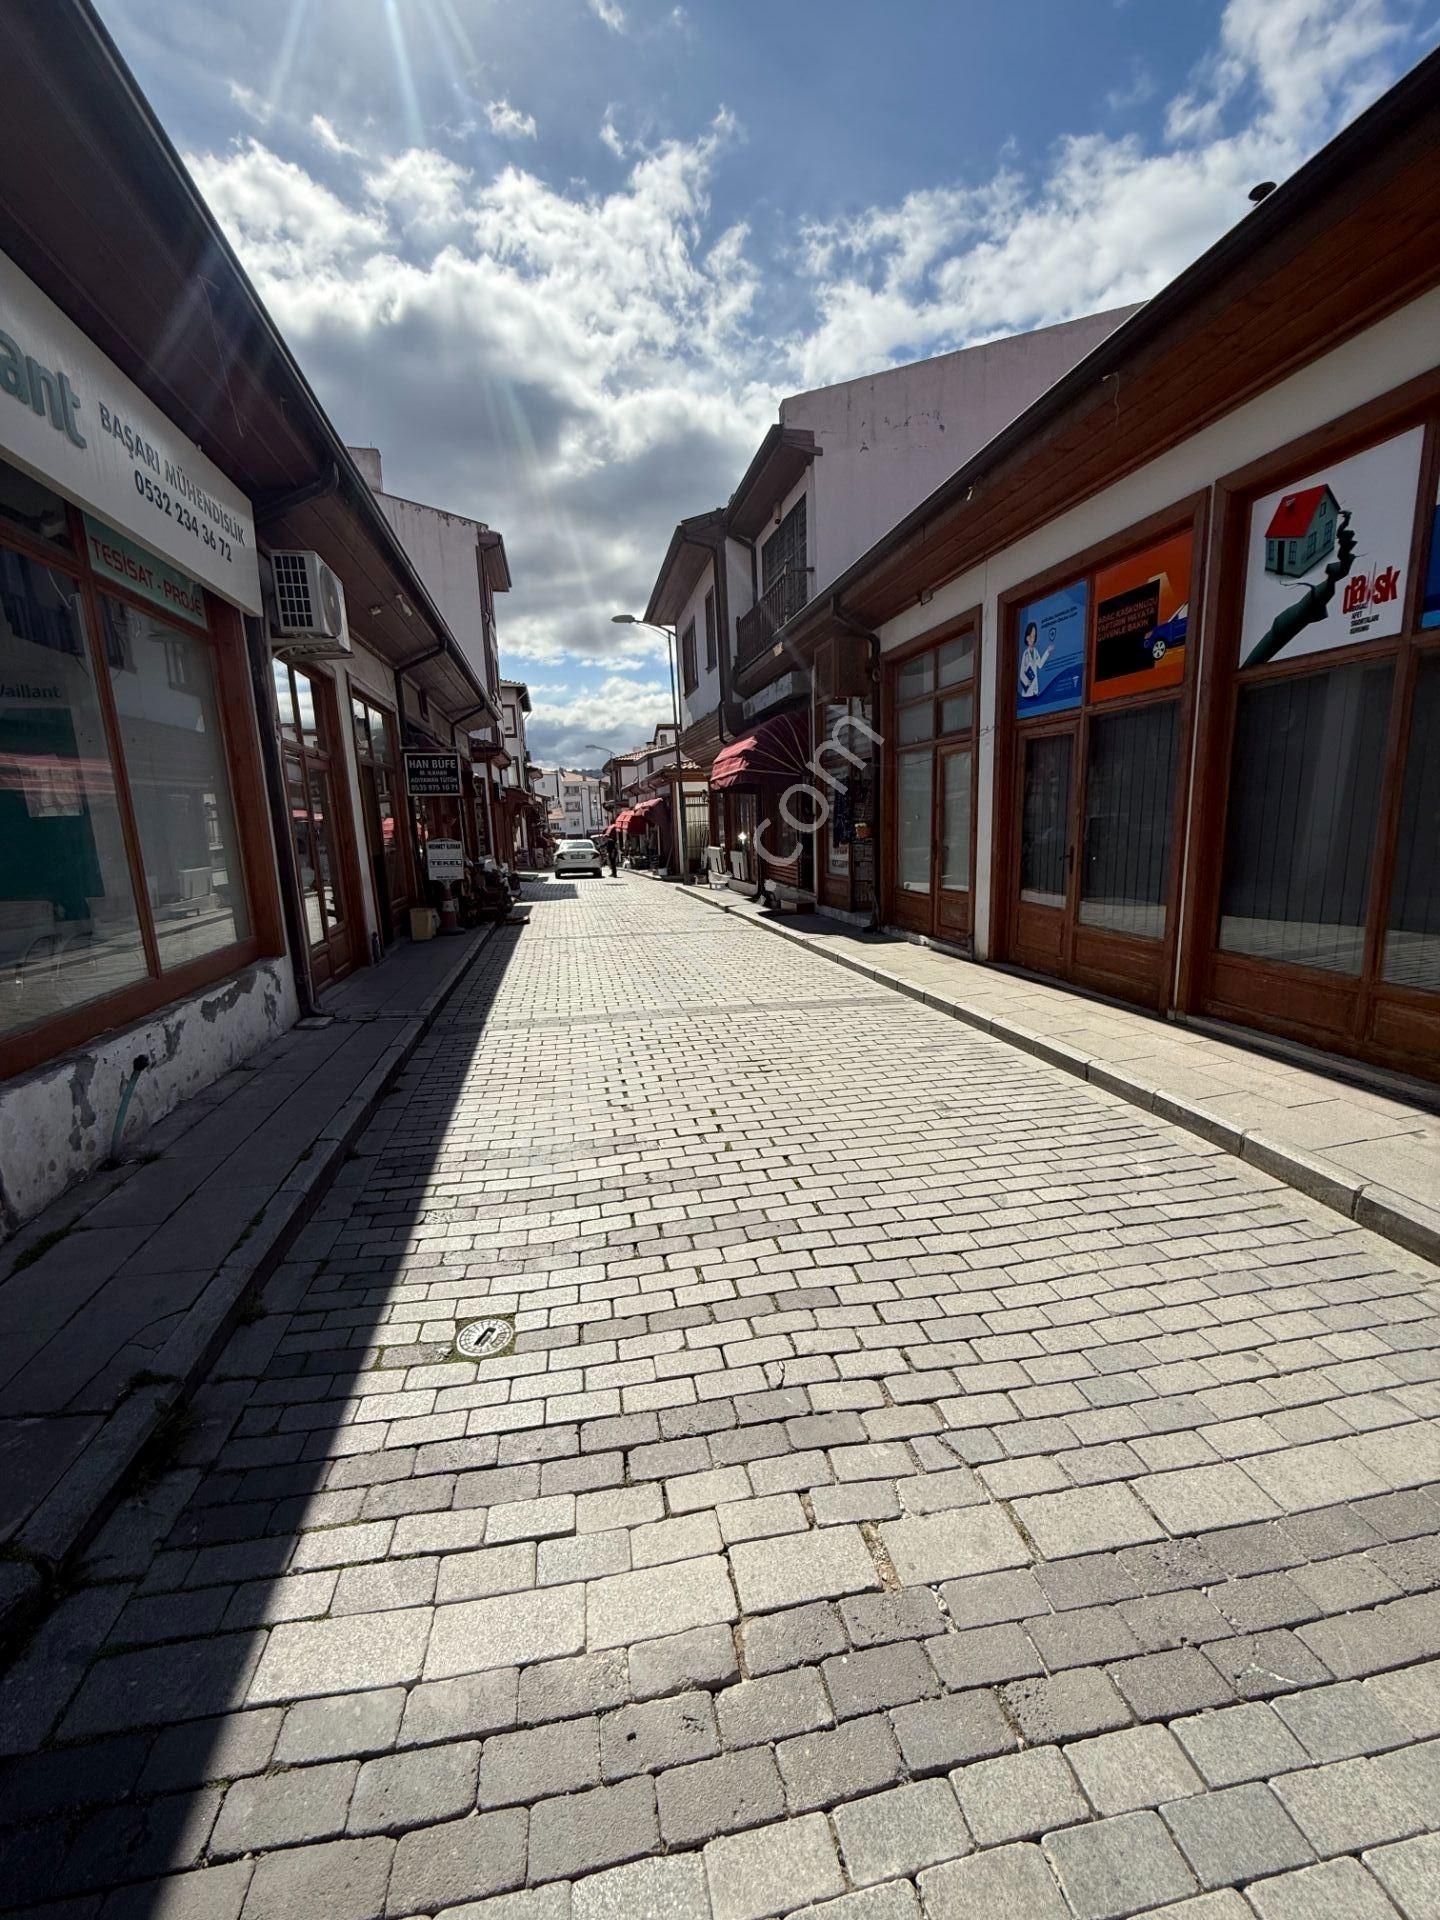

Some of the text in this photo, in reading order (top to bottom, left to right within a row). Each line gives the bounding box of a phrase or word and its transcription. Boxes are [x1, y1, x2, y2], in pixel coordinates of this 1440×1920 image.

[99, 401, 246, 547] BAŞARI MÜHENDİSLİK
[134, 470, 233, 563] 0532 234 36 72
[90, 535, 154, 589] TESİSAT
[163, 579, 202, 617] PROJE
[408, 757, 457, 769] HAN BÜFE
